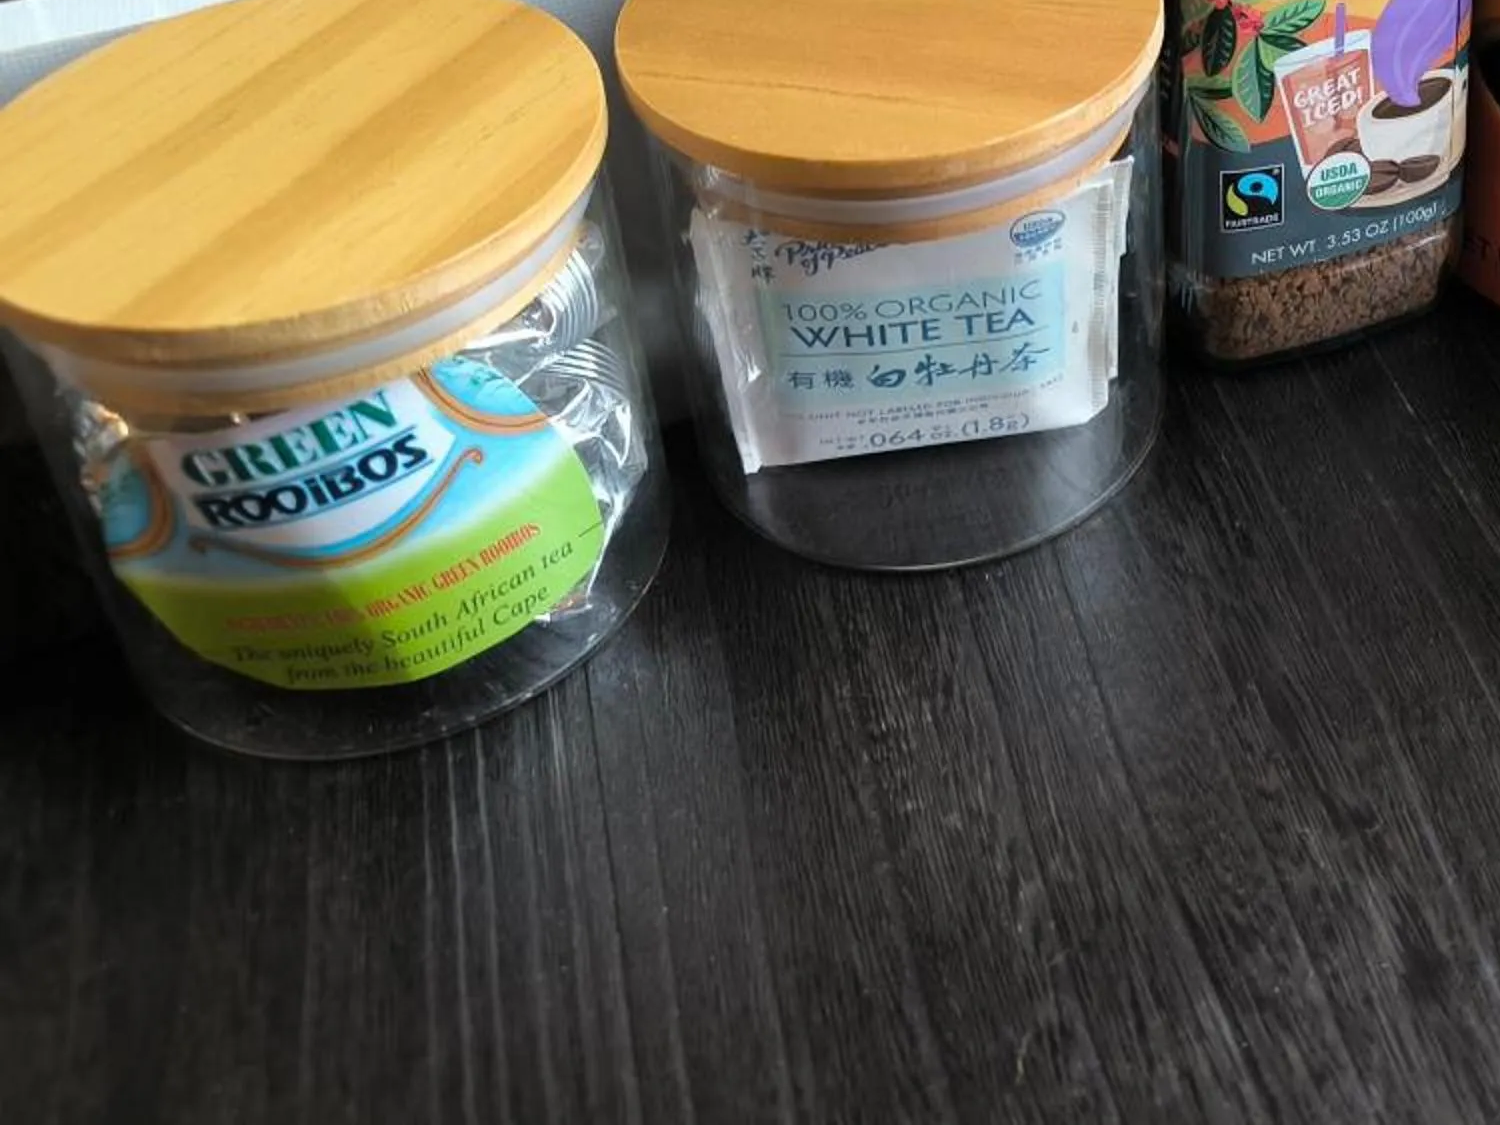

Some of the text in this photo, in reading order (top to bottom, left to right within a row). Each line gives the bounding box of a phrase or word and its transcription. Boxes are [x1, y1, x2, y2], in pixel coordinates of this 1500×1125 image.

[1293, 65, 1362, 109] GREAT
[1302, 89, 1364, 127] ICED!
[1315, 179, 1364, 199] ORGANIC
[1319, 161, 1359, 180] USDA
[1225, 212, 1282, 229] FAIRTRADE
[1251, 245, 1286, 266] NET
[1326, 227, 1362, 249] 3.53
[1364, 218, 1390, 238] OZ
[783, 278, 1043, 324] 100% ORGANIC
[789, 308, 1036, 350] WHITE TEA
[181, 390, 399, 489] GREEN
[431, 558, 482, 592] GREEN
[479, 522, 542, 567] ROOIBOS
[381, 610, 449, 650] South
[455, 566, 537, 622] African
[540, 540, 576, 570] tea
[383, 616, 487, 671] beautiful
[490, 585, 550, 628] Cape
